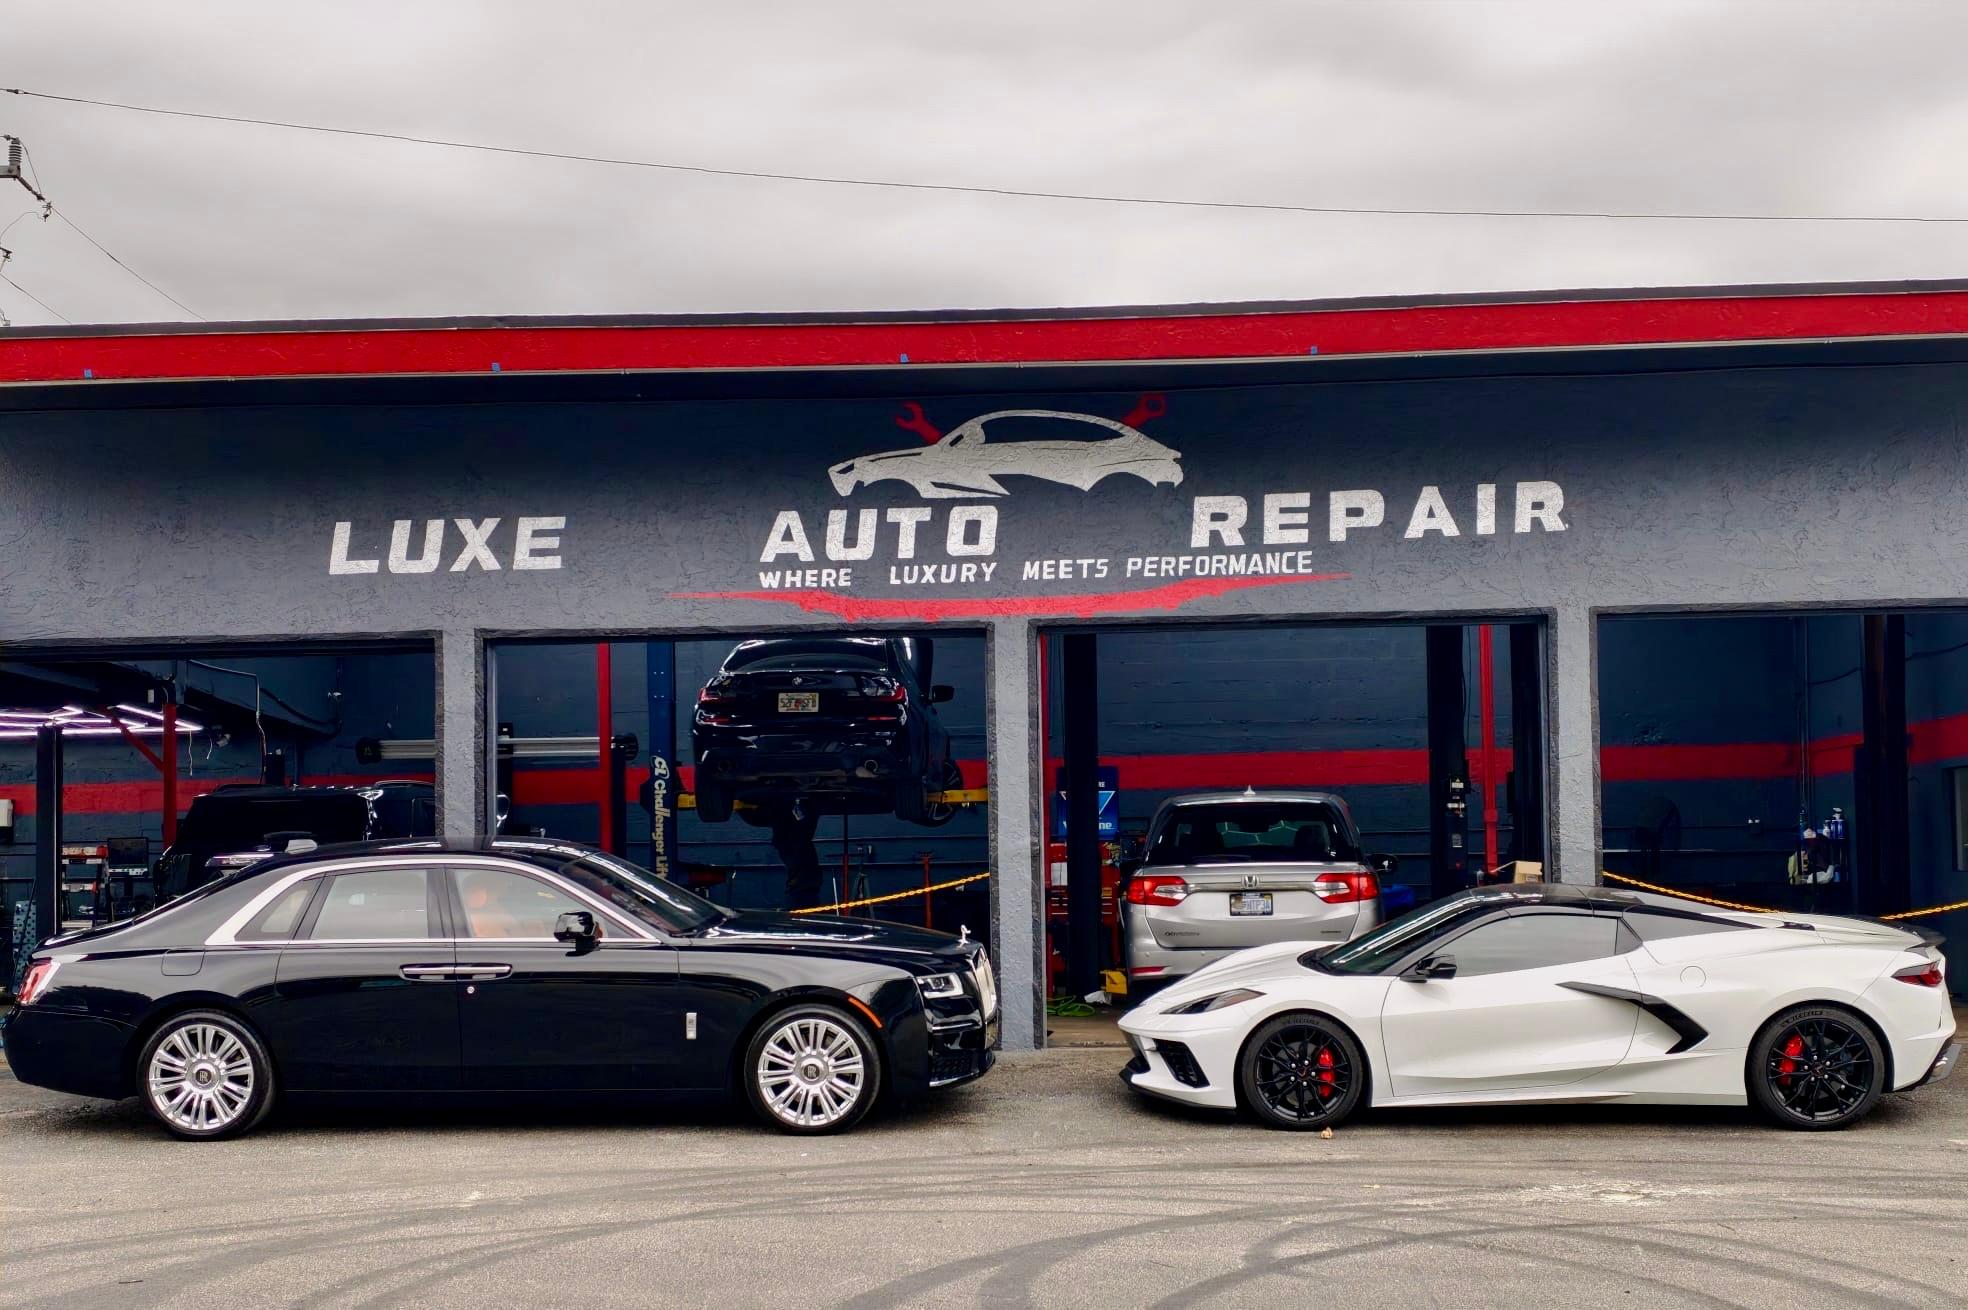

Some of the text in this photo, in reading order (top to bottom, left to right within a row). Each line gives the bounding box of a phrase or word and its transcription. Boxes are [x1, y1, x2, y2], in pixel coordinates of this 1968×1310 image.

[328, 480, 1567, 576] LUXE AUTO REPAIR
[758, 550, 1313, 589] WHERE LUXURY MEETS PERFORMANCE
[652, 780, 670, 855] Challenger
